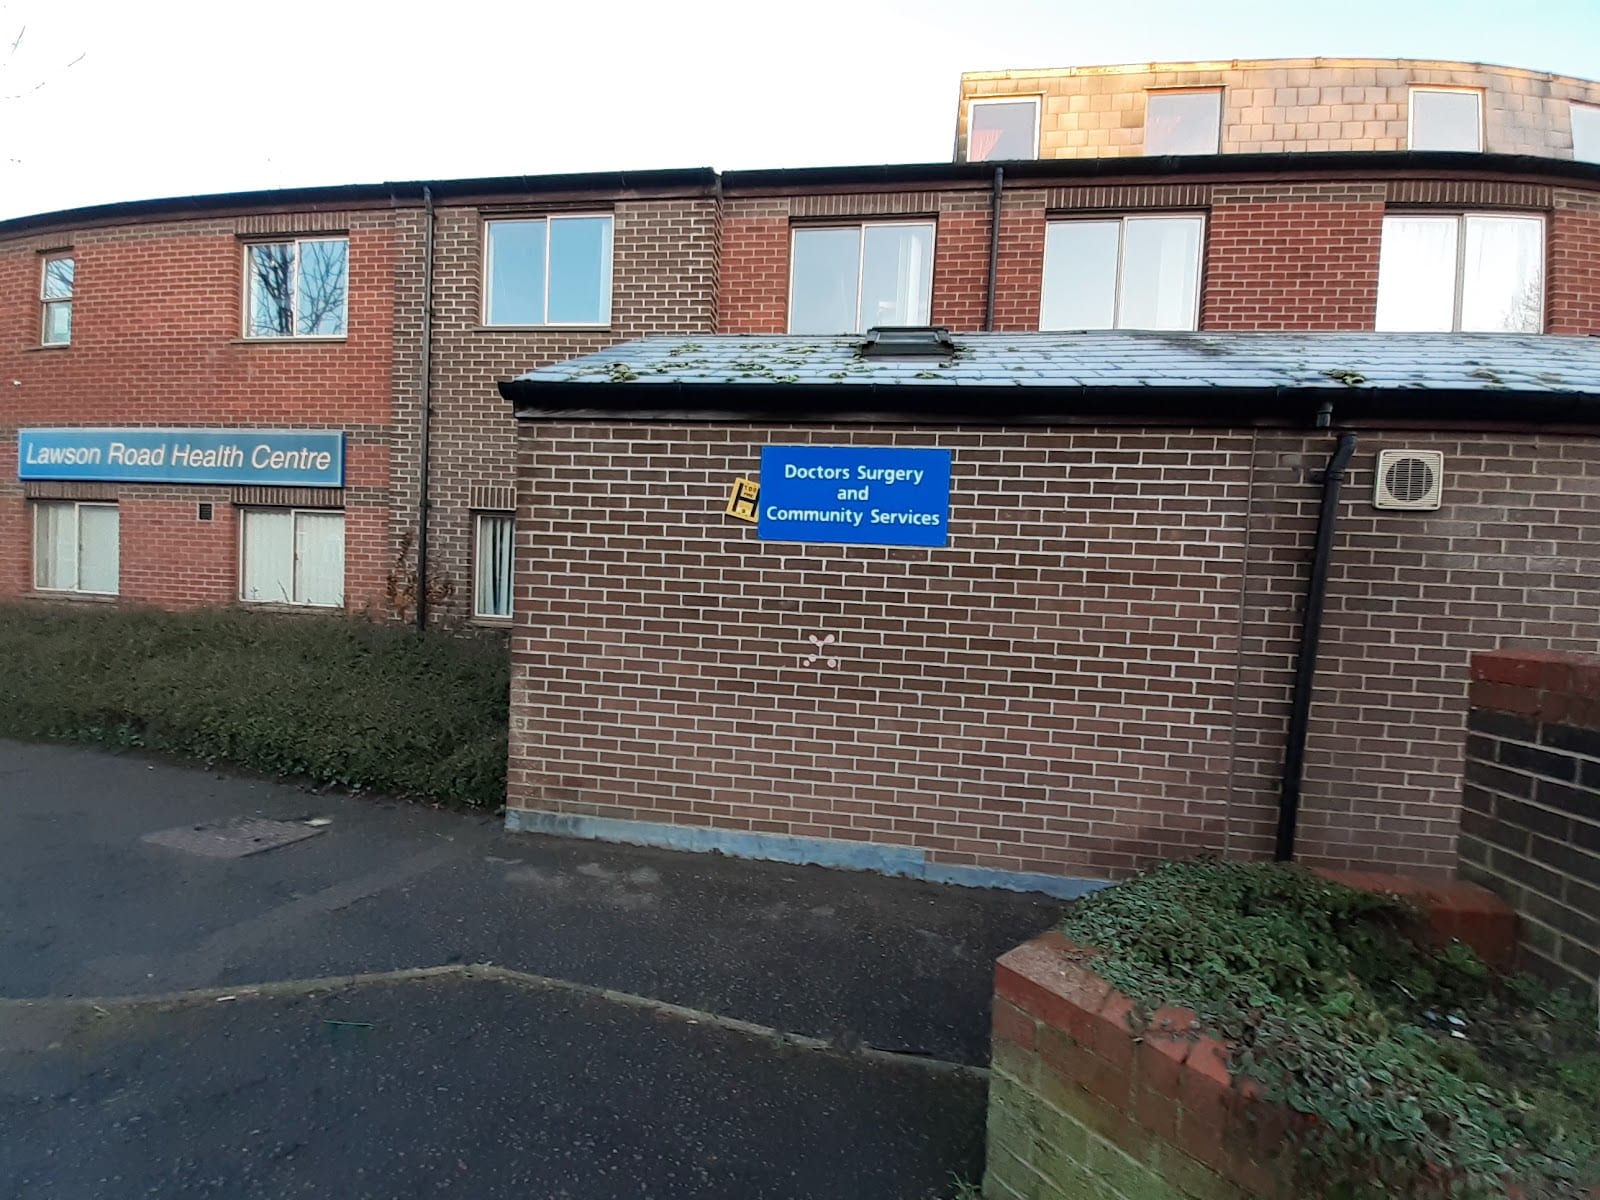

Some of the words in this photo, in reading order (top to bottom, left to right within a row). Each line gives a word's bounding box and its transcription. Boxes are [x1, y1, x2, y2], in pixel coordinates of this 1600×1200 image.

[26, 443, 101, 465] Lawson
[108, 442, 164, 466] Road
[171, 444, 243, 468] Health
[251, 445, 331, 471] Centre
[784, 464, 850, 480] Doctors
[857, 465, 924, 485] Surgery
[837, 486, 869, 501] and
[766, 506, 863, 526] Community
[870, 509, 940, 526] Services
